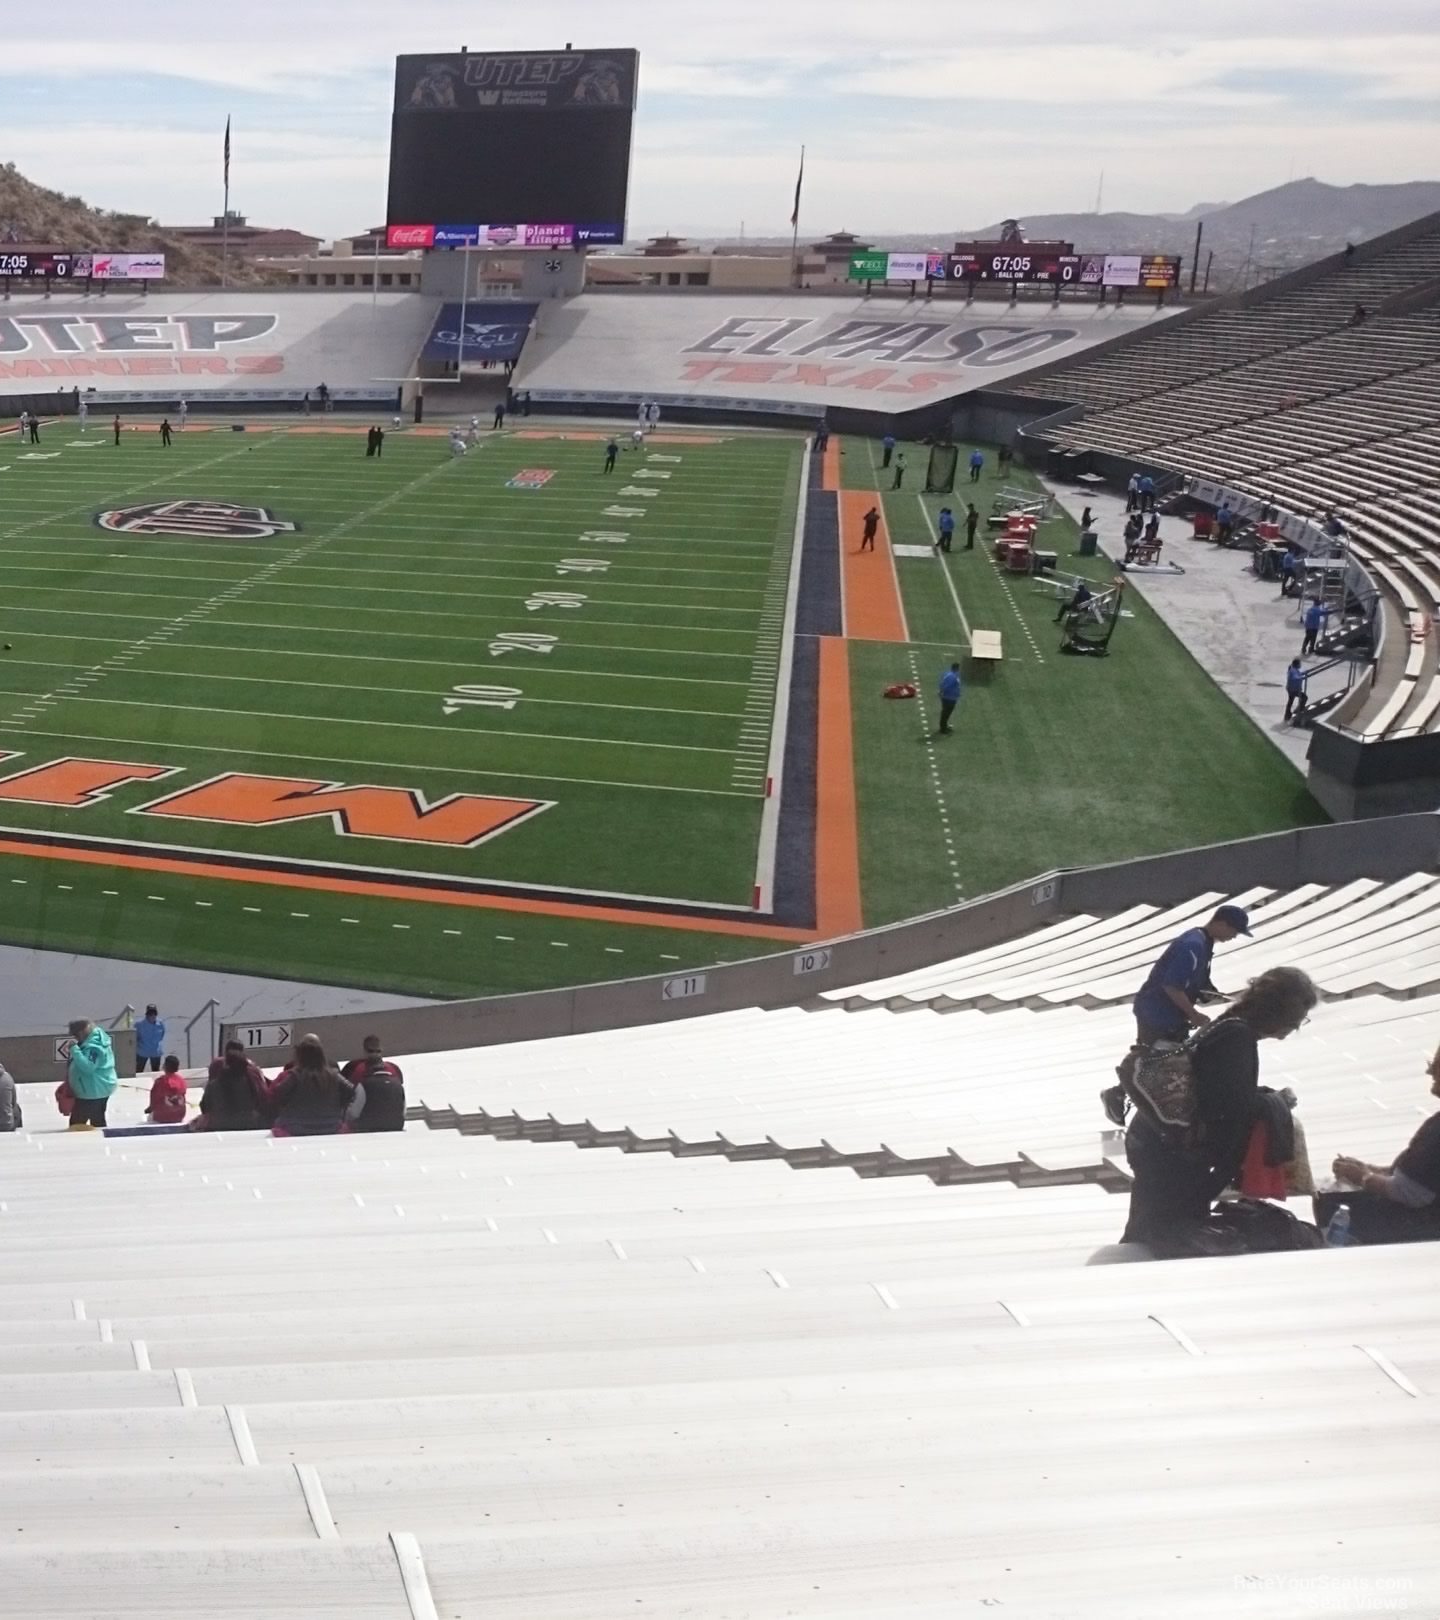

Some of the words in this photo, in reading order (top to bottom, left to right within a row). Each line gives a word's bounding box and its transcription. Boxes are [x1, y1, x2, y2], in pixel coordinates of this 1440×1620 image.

[463, 53, 585, 86] UTEP
[526, 224, 565, 237] planet
[530, 235, 572, 245] fitness
[56, 262, 66, 275] 0
[545, 260, 561, 272] 25
[953, 264, 963, 278] 0
[992, 256, 1031, 271] 67:05
[1063, 266, 1072, 280] 0
[436, 331, 519, 344] GECU
[678, 316, 819, 356] EL
[788, 319, 1081, 368] PASO
[678, 360, 963, 394] TEXAS
[555, 558, 612, 572] 40
[524, 591, 588, 609] 30
[488, 632, 559, 654] 20
[442, 684, 524, 710] 10
[1042, 884, 1053, 900] 10
[800, 955, 815, 972] 10
[683, 978, 697, 995] 11
[247, 1029, 262, 1046] 11
